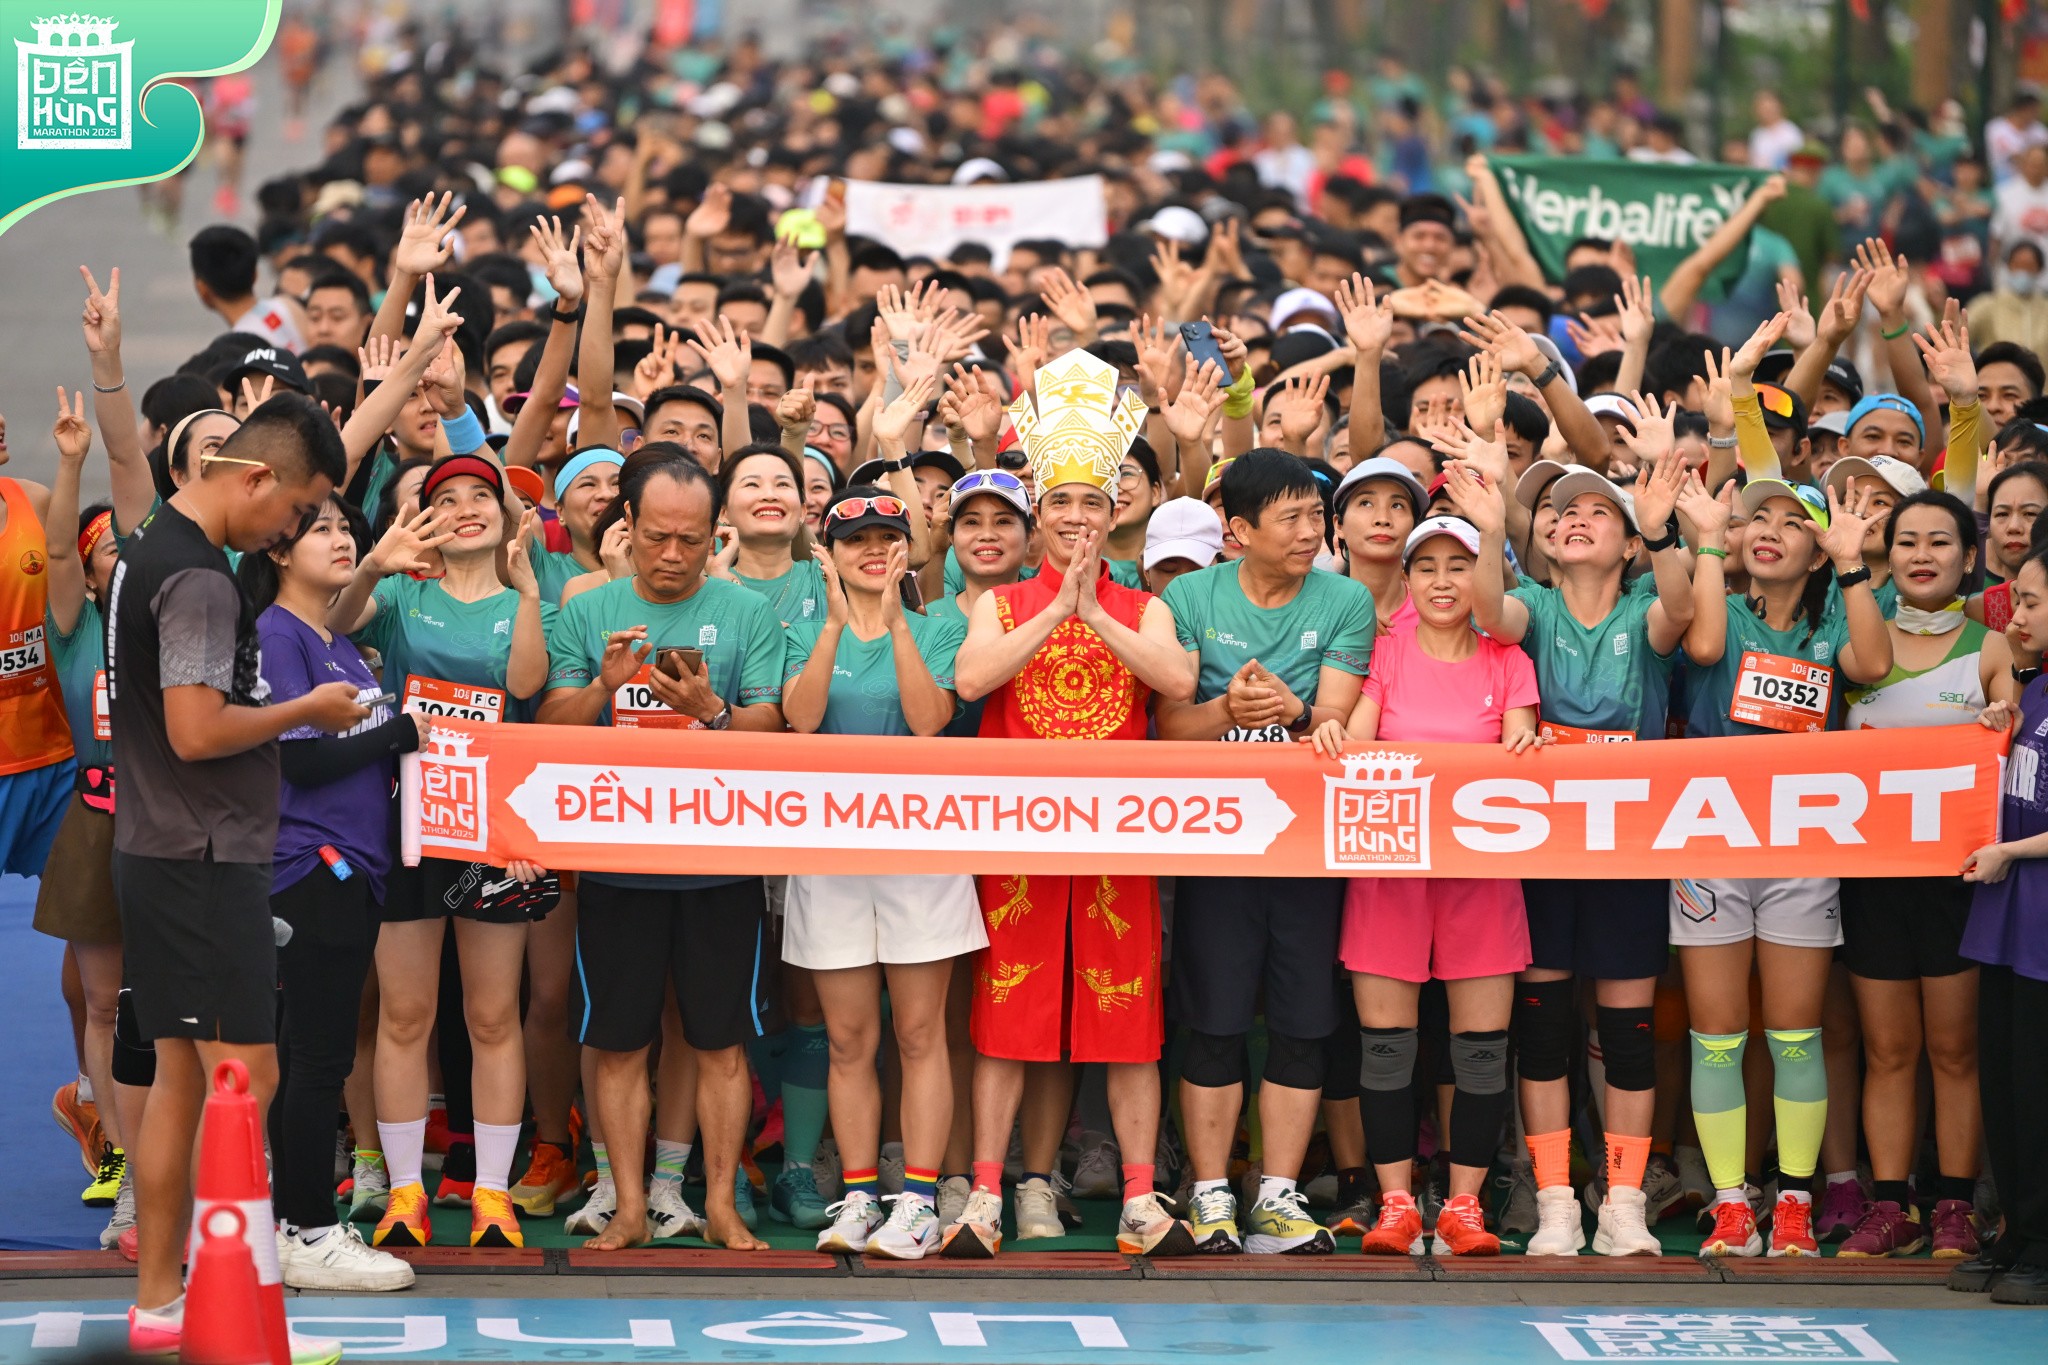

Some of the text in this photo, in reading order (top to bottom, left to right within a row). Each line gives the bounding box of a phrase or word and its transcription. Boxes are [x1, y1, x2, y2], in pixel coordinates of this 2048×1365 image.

[0, 646, 39, 671] 534
[1791, 663, 1802, 673] 10
[1810, 670, 1817, 680] F
[1820, 673, 1828, 684] C
[453, 687, 465, 698] 10
[475, 694, 482, 704] F
[488, 696, 498, 707] C
[1753, 676, 1819, 708] 10352
[555, 770, 1243, 835] ĐỀN HÙNG MARATHON 2025
[1452, 764, 1976, 852] START
[420, 826, 474, 839] ATHON 2025
[1339, 854, 1417, 862] MARATHON 2025
